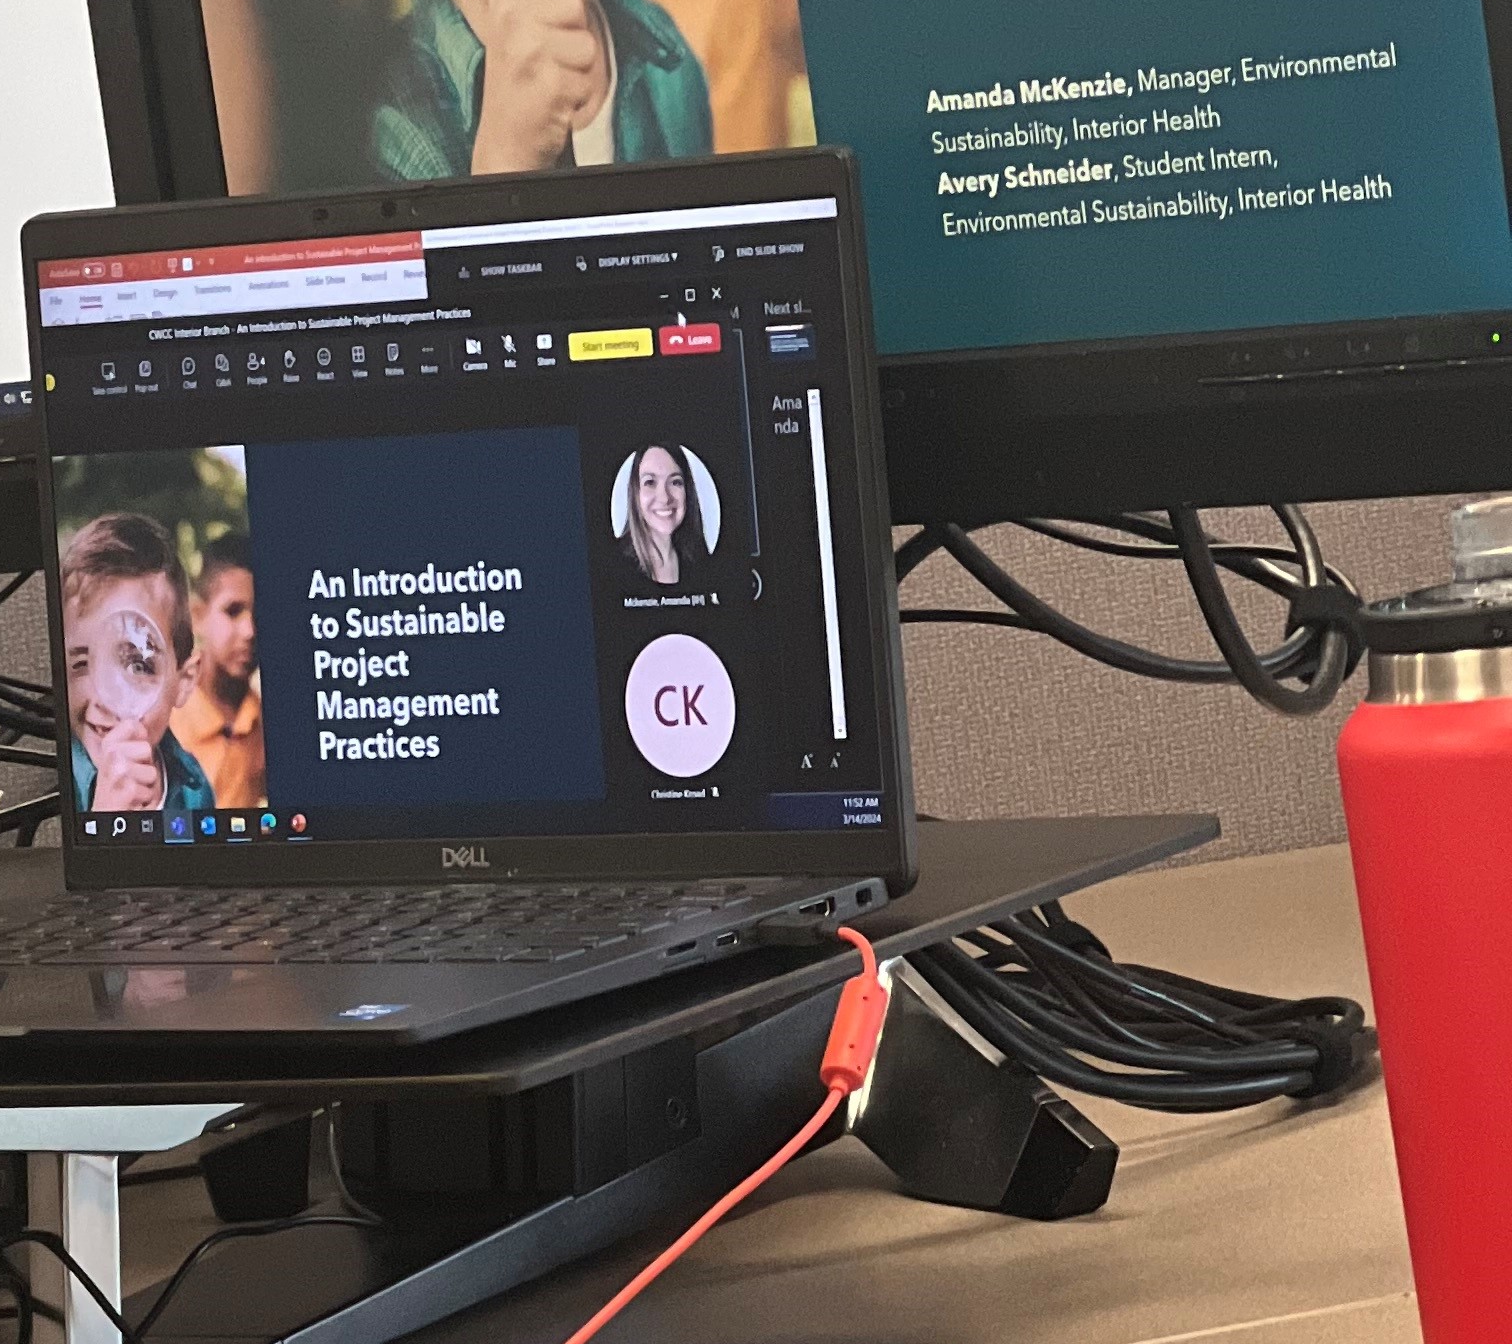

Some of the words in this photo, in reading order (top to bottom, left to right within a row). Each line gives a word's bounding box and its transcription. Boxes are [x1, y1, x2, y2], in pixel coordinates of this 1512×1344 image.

[926, 83, 1015, 113] Amanda
[1020, 72, 1133, 104] McKenzie,
[1137, 64, 1236, 94] Manager,
[1241, 42, 1397, 83] Environmental
[931, 121, 1069, 155] Sustainability,
[1072, 113, 1148, 140] Interior
[1152, 104, 1221, 133] Health
[937, 172, 999, 198] Avery
[1004, 158, 1119, 189] Schneider,
[1122, 151, 1206, 179] Student
[1210, 147, 1278, 172] Intern,
[943, 201, 1087, 237] Environmental
[1091, 190, 1233, 224] Sustainability,
[1238, 183, 1315, 211] Interior
[1320, 174, 1392, 202] Health
[237, 323, 248, 333] An
[298, 320, 307, 330] to
[308, 316, 352, 329] Sustainable
[353, 315, 381, 327] Project
[383, 311, 435, 325] Management
[436, 309, 472, 320] Practices
[764, 301, 789, 316] Next
[687, 334, 713, 346] Leave
[773, 395, 802, 412] Ama
[774, 418, 800, 435] nda
[308, 570, 346, 599] An
[352, 560, 523, 597] Introduction
[310, 613, 339, 639] to
[345, 601, 506, 638] Sustainable
[314, 647, 410, 687] Project
[316, 688, 500, 726] Management
[654, 684, 708, 727] CK
[319, 728, 440, 760] Practices
[843, 798, 863, 808] 11:52
[864, 797, 879, 807] AM
[843, 813, 882, 825] 3/14/2024
[442, 846, 491, 868] DELL
